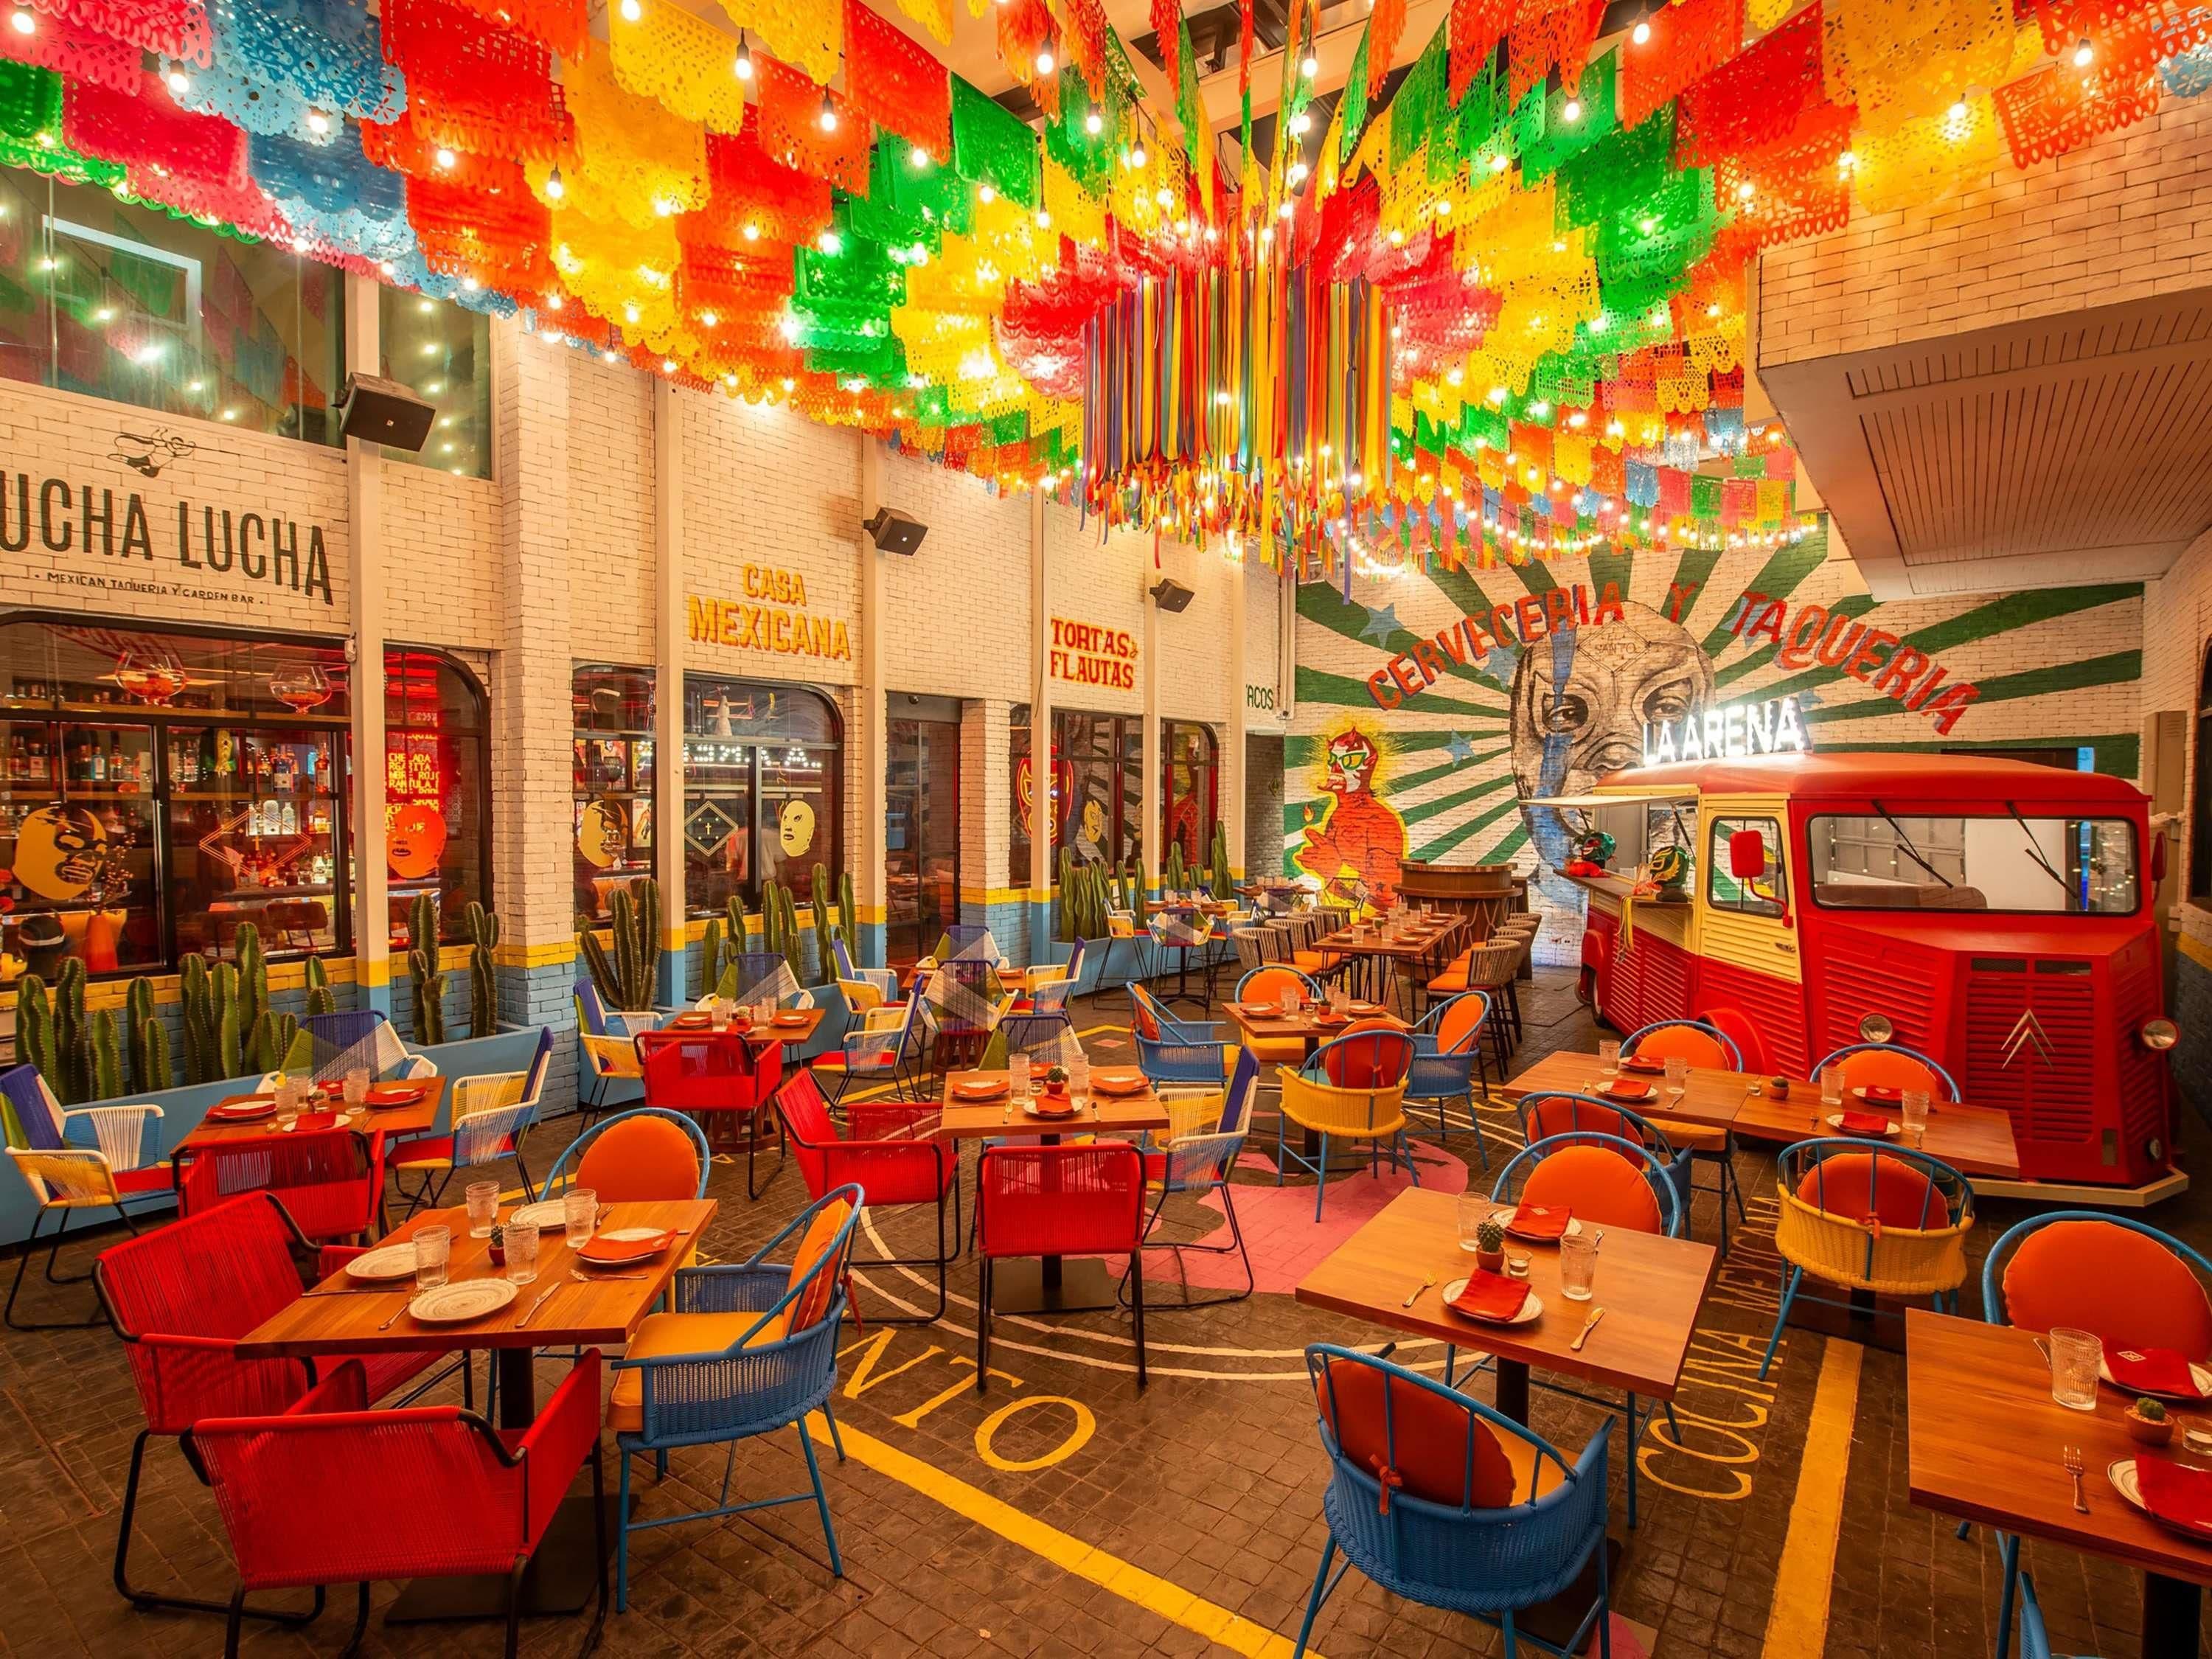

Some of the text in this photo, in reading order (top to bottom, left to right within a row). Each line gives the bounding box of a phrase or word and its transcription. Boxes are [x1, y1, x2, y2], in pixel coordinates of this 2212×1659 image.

[179, 501, 333, 605] LUCHA
[742, 563, 807, 606] CASA
[47, 572, 105, 588] MEXICAN
[172, 587, 179, 596] Y
[232, 594, 254, 604] BAR
[689, 595, 852, 661] MEXICANA
[1051, 618, 1130, 658] TORTAS
[1367, 581, 1981, 736] CERVECERIA Y TAQUERIA
[1051, 650, 1134, 689] FLAUTAS
[1245, 684, 1274, 710] ACOS
[1644, 697, 1810, 767] LA ARENA
[834, 1310, 1096, 1472] NTO
[1636, 1329, 1787, 1500] COCINA
